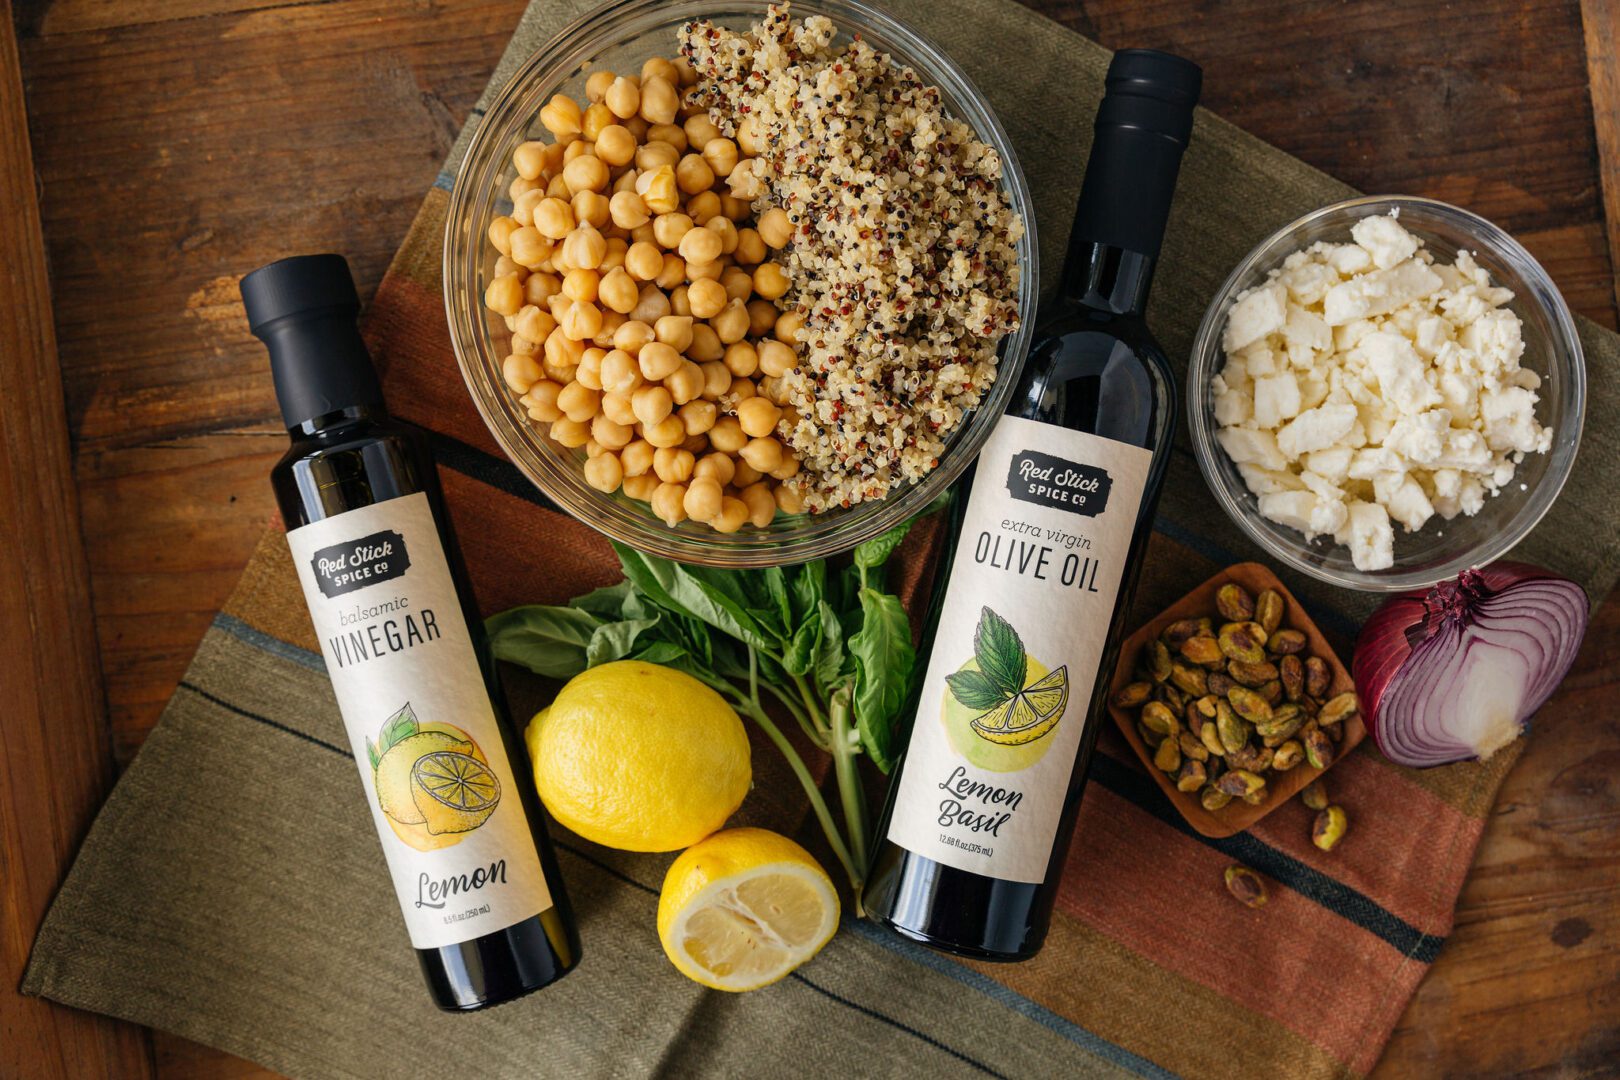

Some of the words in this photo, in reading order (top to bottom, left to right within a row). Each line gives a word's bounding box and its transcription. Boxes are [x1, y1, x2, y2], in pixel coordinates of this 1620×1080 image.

[1018, 458, 1053, 482] Red
[1054, 468, 1100, 493] Stick
[1028, 483, 1069, 502] SPICE
[1001, 518, 1041, 538] extra
[1046, 528, 1092, 550] virgin
[318, 553, 347, 579] Red
[349, 541, 393, 567] Stick
[334, 567, 372, 587] SPICE
[974, 531, 1053, 580] OLIVE
[1060, 553, 1099, 593] OIL
[339, 596, 409, 626] balsamic
[329, 608, 441, 668] VINEGAR
[938, 766, 1023, 811] Lemon
[937, 799, 1011, 837] Basil
[415, 859, 507, 909] Lemon
